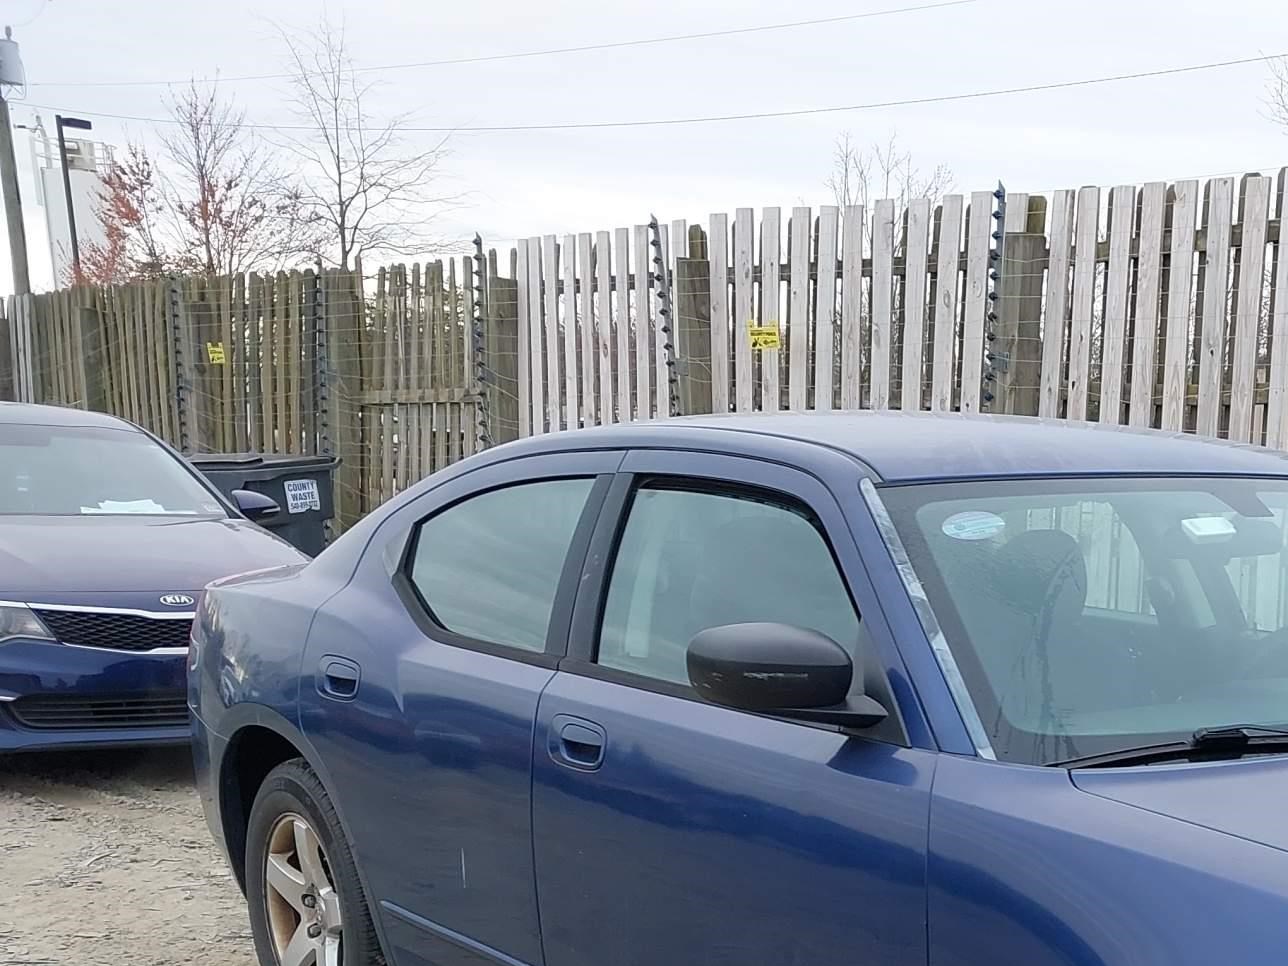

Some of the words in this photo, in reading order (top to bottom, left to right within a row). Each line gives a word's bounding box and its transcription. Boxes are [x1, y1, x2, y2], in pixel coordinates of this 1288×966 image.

[288, 482, 314, 491] COUNTY
[291, 492, 315, 501] WASTE
[163, 595, 192, 605] KIA
